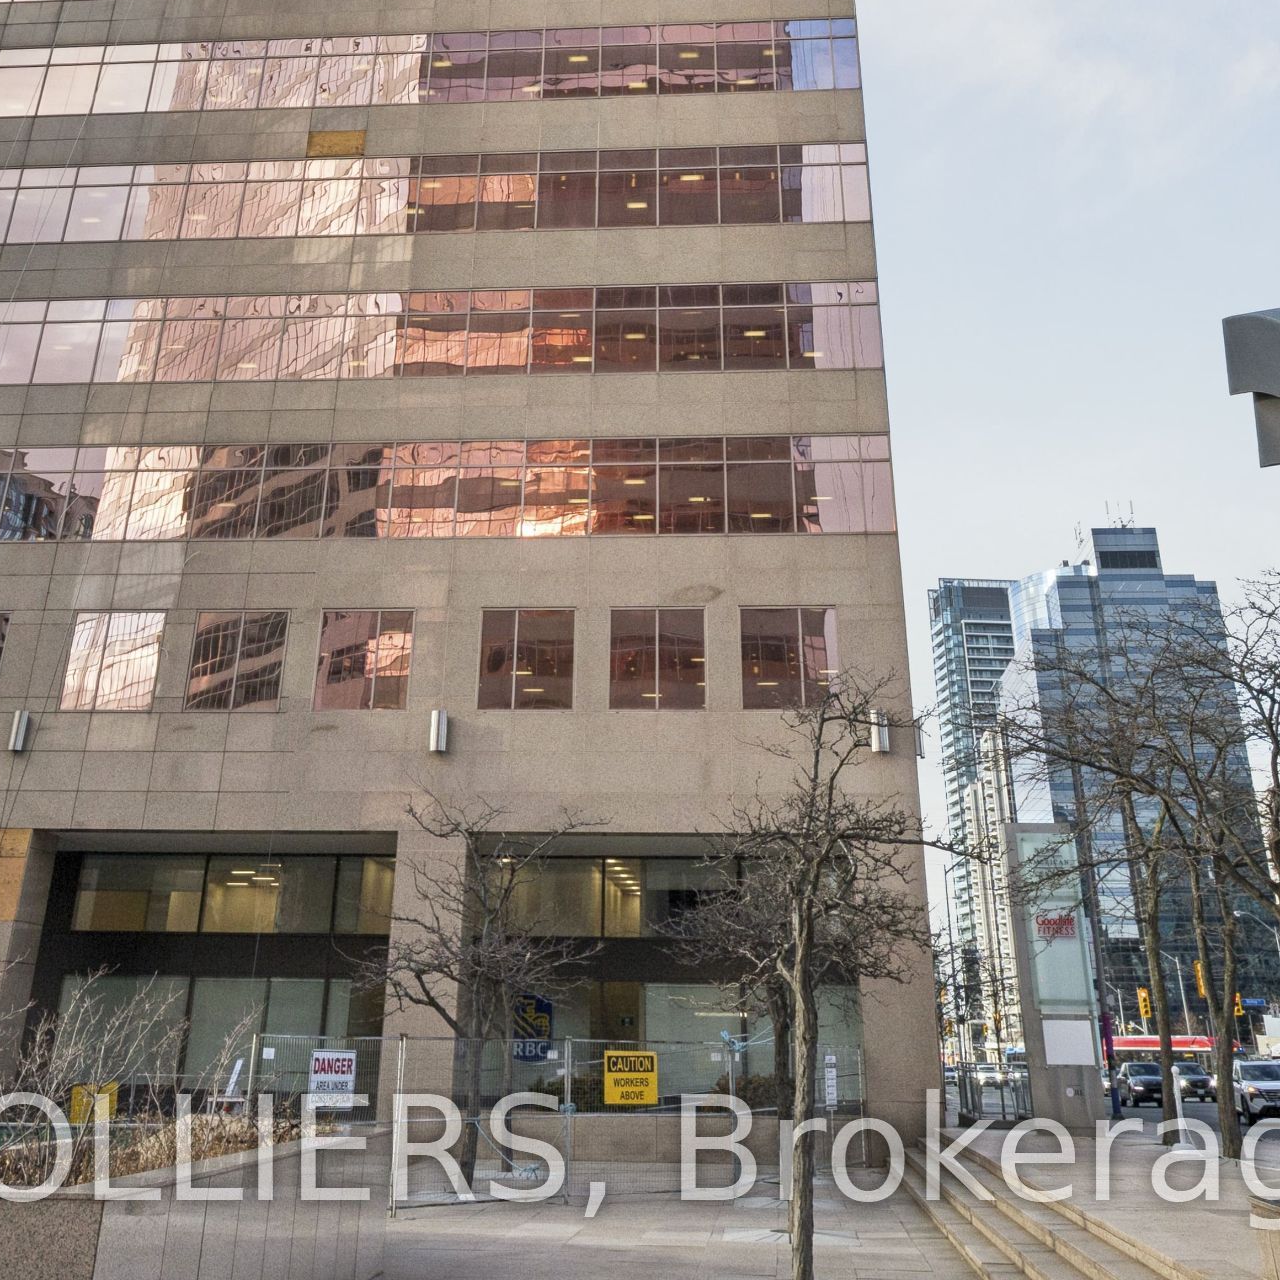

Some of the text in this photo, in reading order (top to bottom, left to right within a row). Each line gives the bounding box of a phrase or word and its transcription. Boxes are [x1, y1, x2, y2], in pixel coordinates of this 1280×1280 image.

[1037, 926, 1075, 936] FITNESS
[512, 1041, 548, 1057] RBC
[313, 1057, 354, 1075] DANGER
[610, 1057, 652, 1072] CAUTION
[315, 1081, 349, 1091] AREA UNDER
[613, 1077, 650, 1088] WORKERS
[620, 1090, 645, 1101] ABOVE
